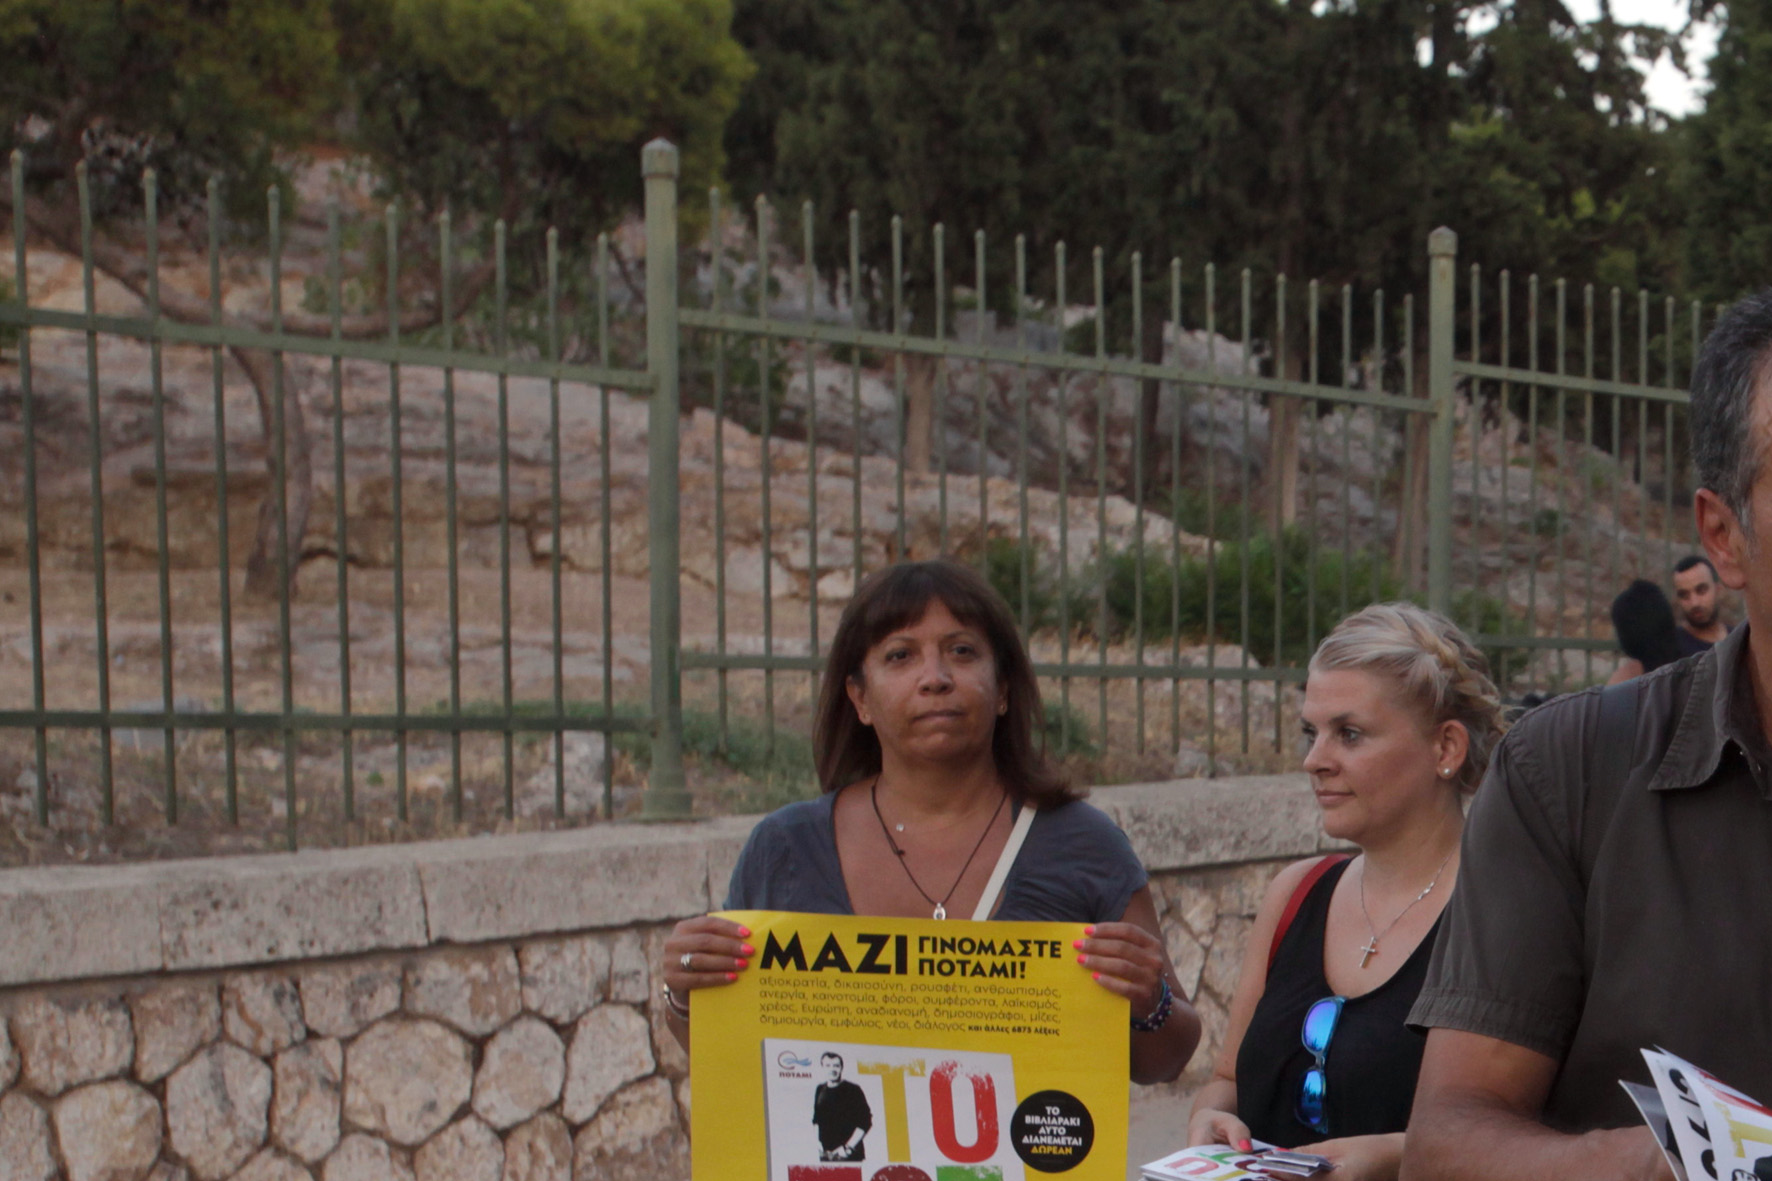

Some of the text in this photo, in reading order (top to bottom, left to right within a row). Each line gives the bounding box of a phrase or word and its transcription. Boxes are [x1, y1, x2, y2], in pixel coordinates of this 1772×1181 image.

[760, 929, 909, 976] ΜΑΖΙ
[918, 936, 1062, 958] ΓΙΝΟΜΑΣΤΕ
[918, 958, 1026, 979] ΠΟΤΑΜΙ!
[759, 976, 1061, 998] αξιοκρατία, δικαιοσύνη, ρουσφέτι, ανθρωπισμός,
[759, 988, 808, 1000] ανεργία,
[813, 993, 878, 1004] καινοτομία,
[882, 994, 918, 1006] φόροι,
[923, 995, 998, 1008] συμφέροντα,
[759, 1001, 798, 1013] χρέος,
[856, 1006, 929, 1018] αναδιανομή,
[934, 1008, 1026, 1023] δημοσιογράφοι,
[759, 1014, 826, 1027] δημιουργία,
[914, 1020, 965, 1032] διάλογος
[857, 1057, 999, 1164] ΤΟ
[1045, 1106, 1060, 1116] ΤΟ
[1024, 1115, 1081, 1127] ΒΙΒΛΙΑΡΑΚΙ
[1038, 1126, 1067, 1136] ΑΥΤΟ
[1021, 1134, 1082, 1147] ΔΙΑΝΕΜΕΤΑΙ
[1030, 1145, 1073, 1155] ΔΩΡΕΑΝ
